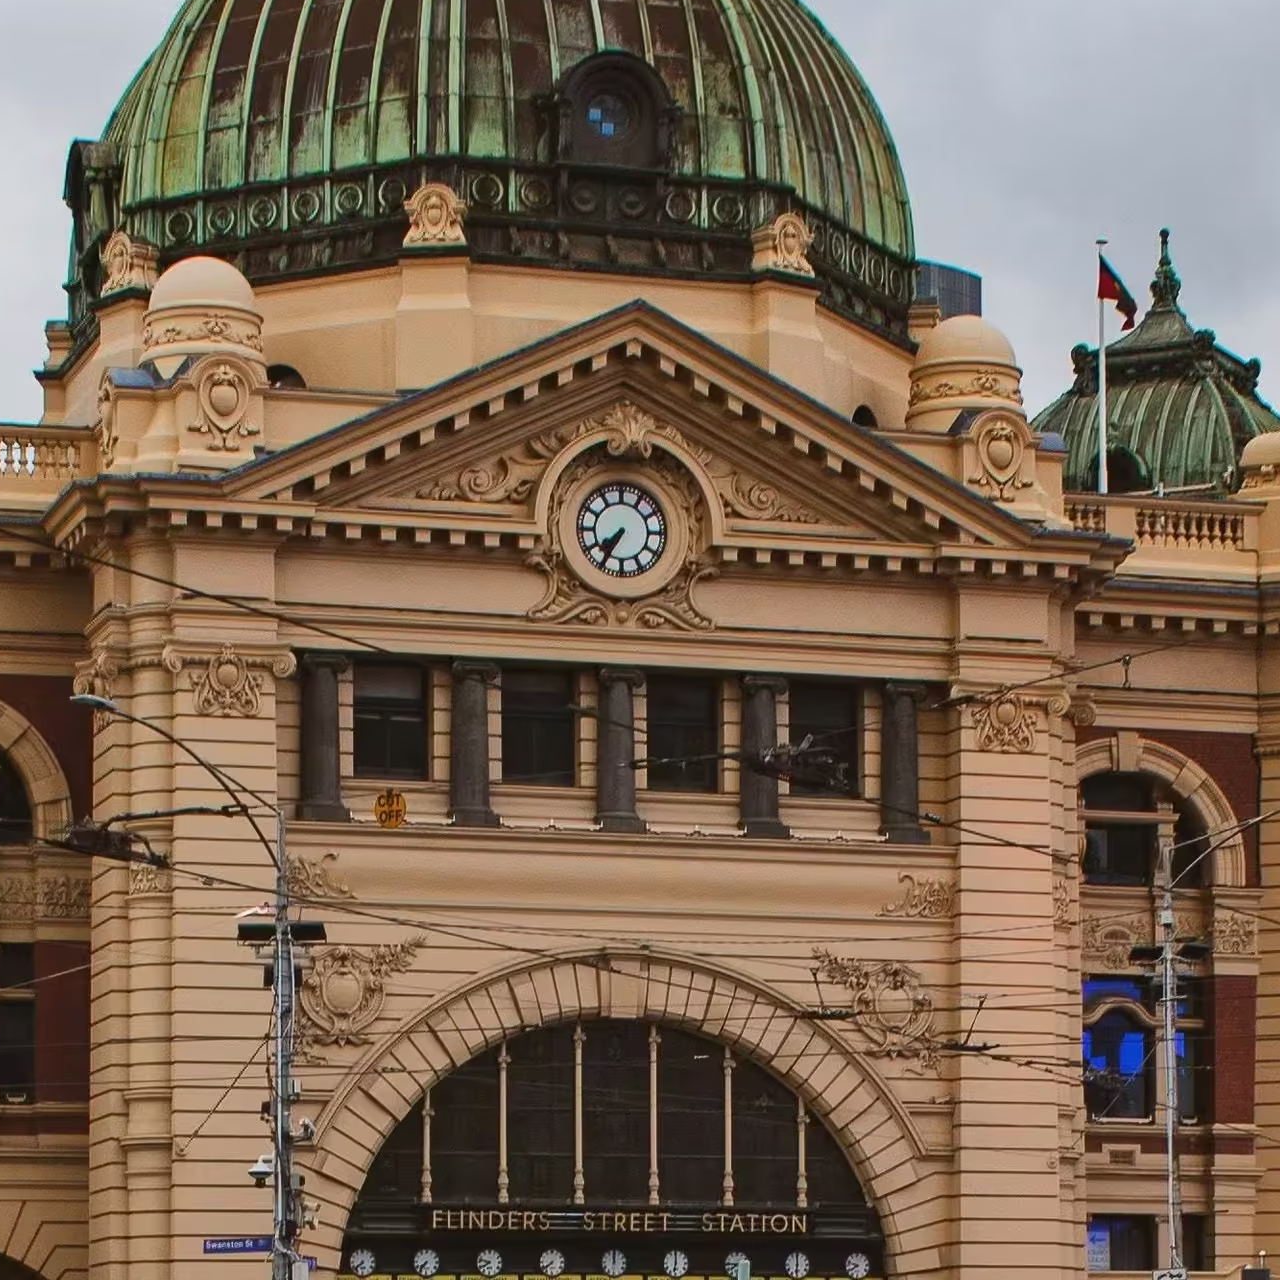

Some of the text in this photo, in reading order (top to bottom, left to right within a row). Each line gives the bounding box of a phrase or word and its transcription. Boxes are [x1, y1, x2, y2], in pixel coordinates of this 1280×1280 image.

[377, 794, 401, 808] CUT
[379, 808, 402, 823] OFF
[431, 1209, 807, 1233] FLINDERS STREET STATION
[205, 1240, 253, 1249] Swanston St
